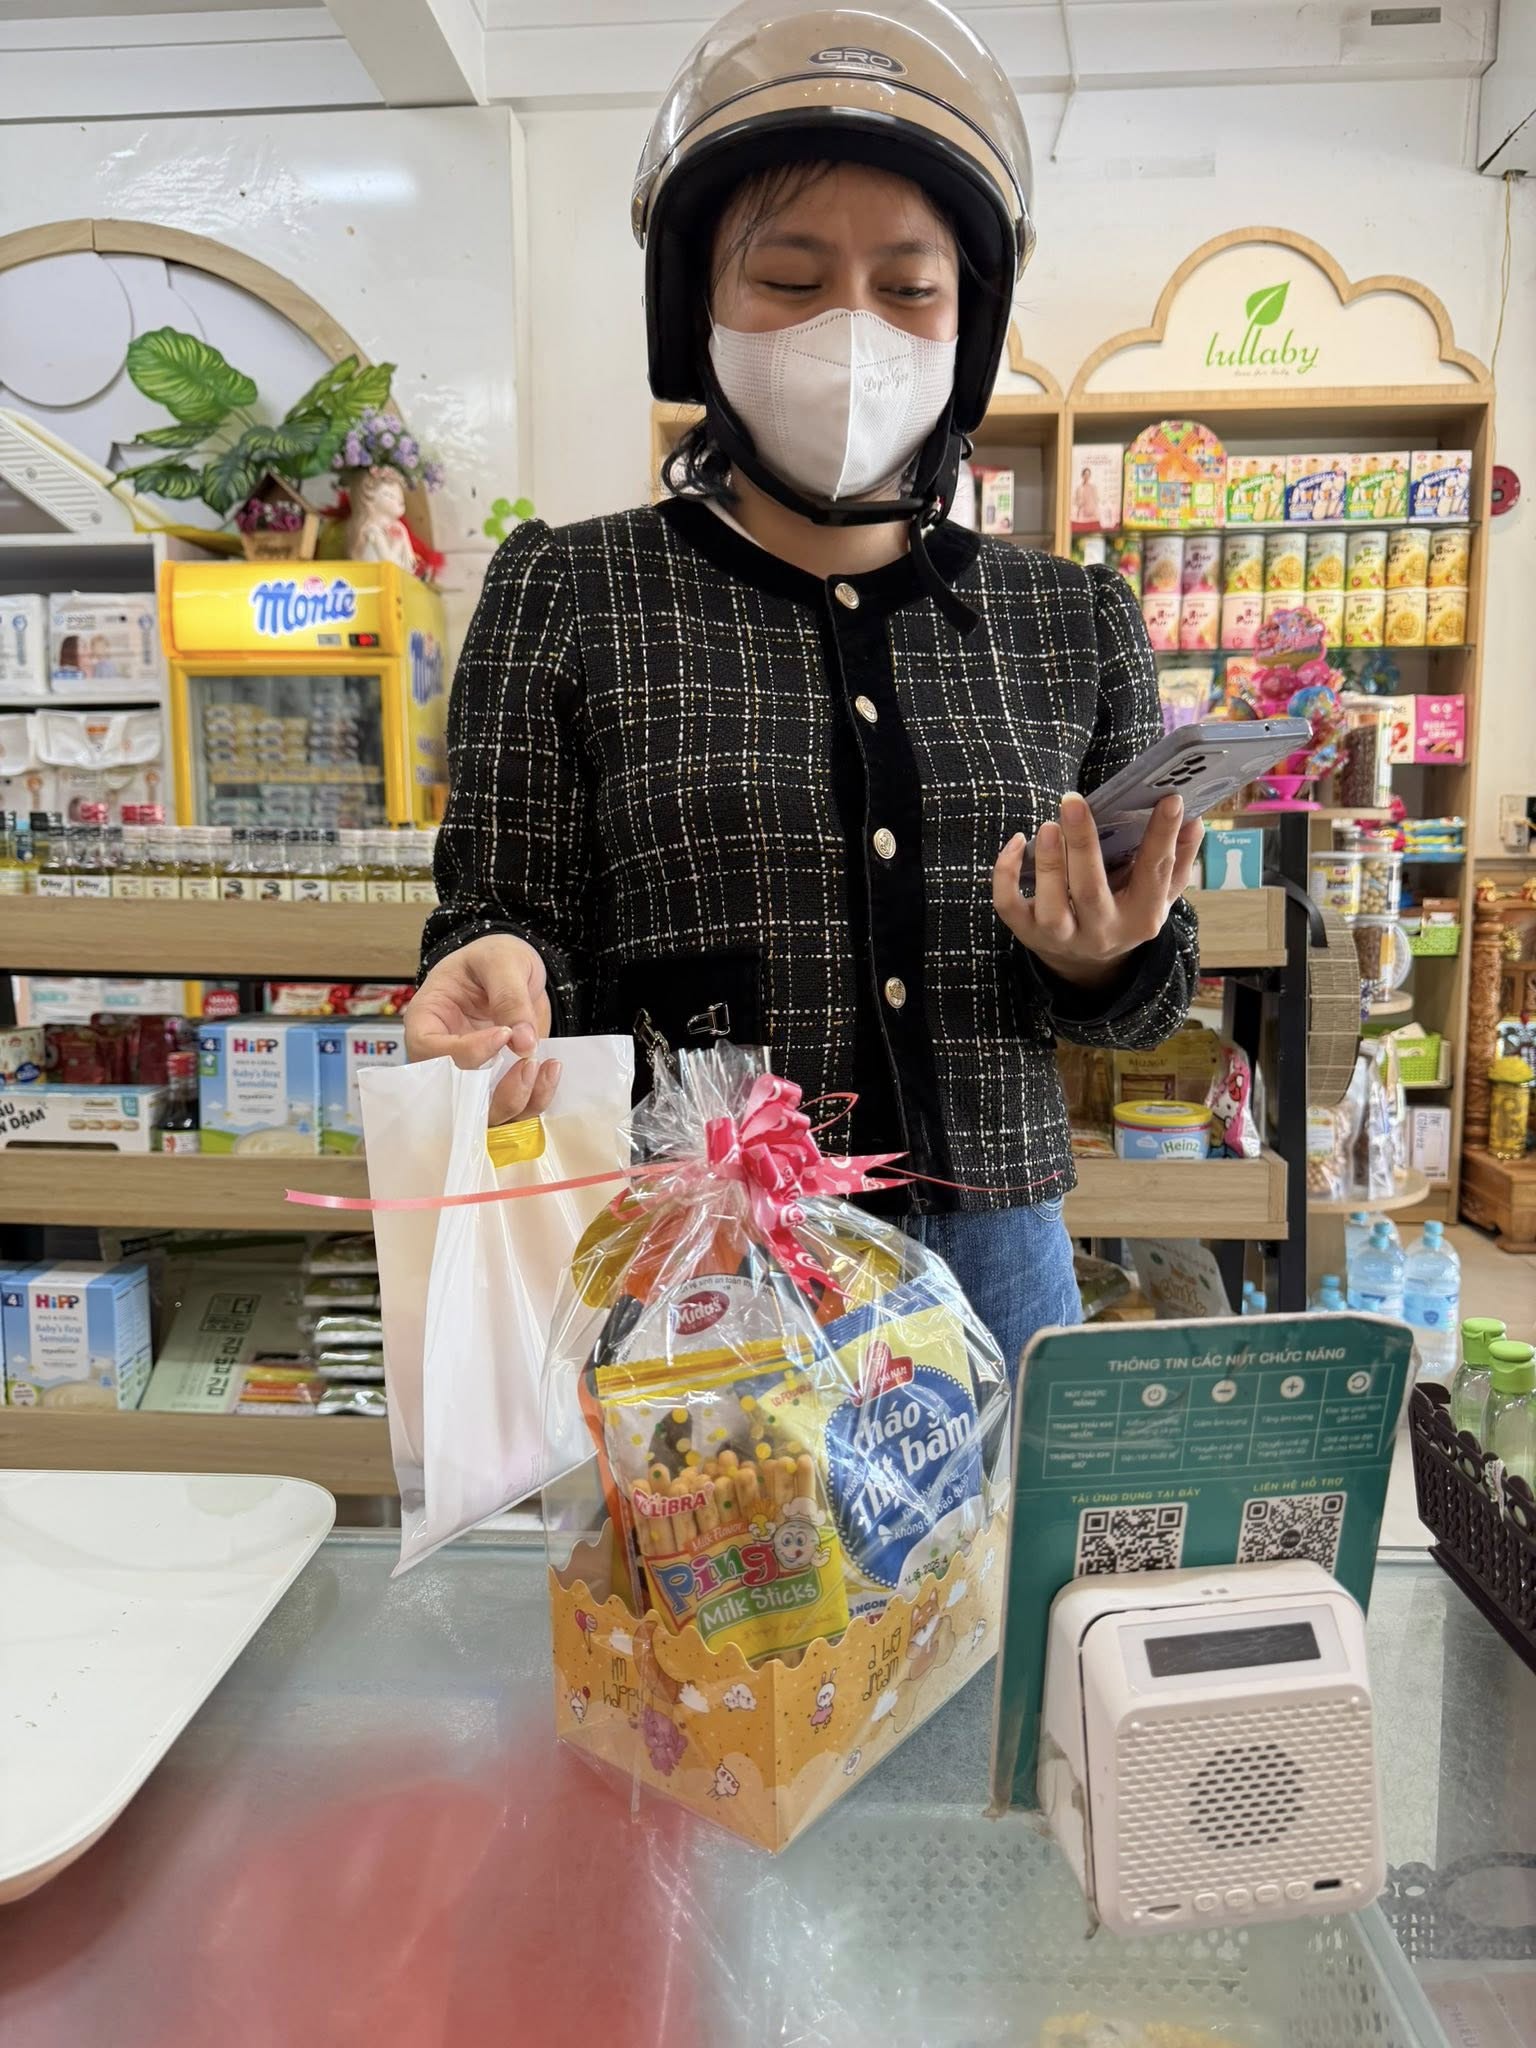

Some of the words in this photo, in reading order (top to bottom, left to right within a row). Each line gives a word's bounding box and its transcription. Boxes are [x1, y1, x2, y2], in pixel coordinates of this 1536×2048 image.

[818, 50, 892, 69] GRO
[1205, 327, 1319, 375] lullaby
[253, 580, 355, 633] Monte
[233, 1039, 278, 1053] HiPP
[353, 1040, 398, 1055] HiPP
[1164, 1140, 1199, 1153] Heinz
[35, 1294, 79, 1309] HiPP
[1108, 1356, 1160, 1372] THÔNG
[1166, 1358, 1188, 1369] TIN
[1191, 1353, 1222, 1367] CÁC
[1259, 1348, 1302, 1364] CHỨC
[1305, 1347, 1346, 1361] NĂNG
[703, 1594, 750, 1631] Milk
[750, 1582, 818, 1610] Sticks
[856, 1600, 887, 1614] NGON
